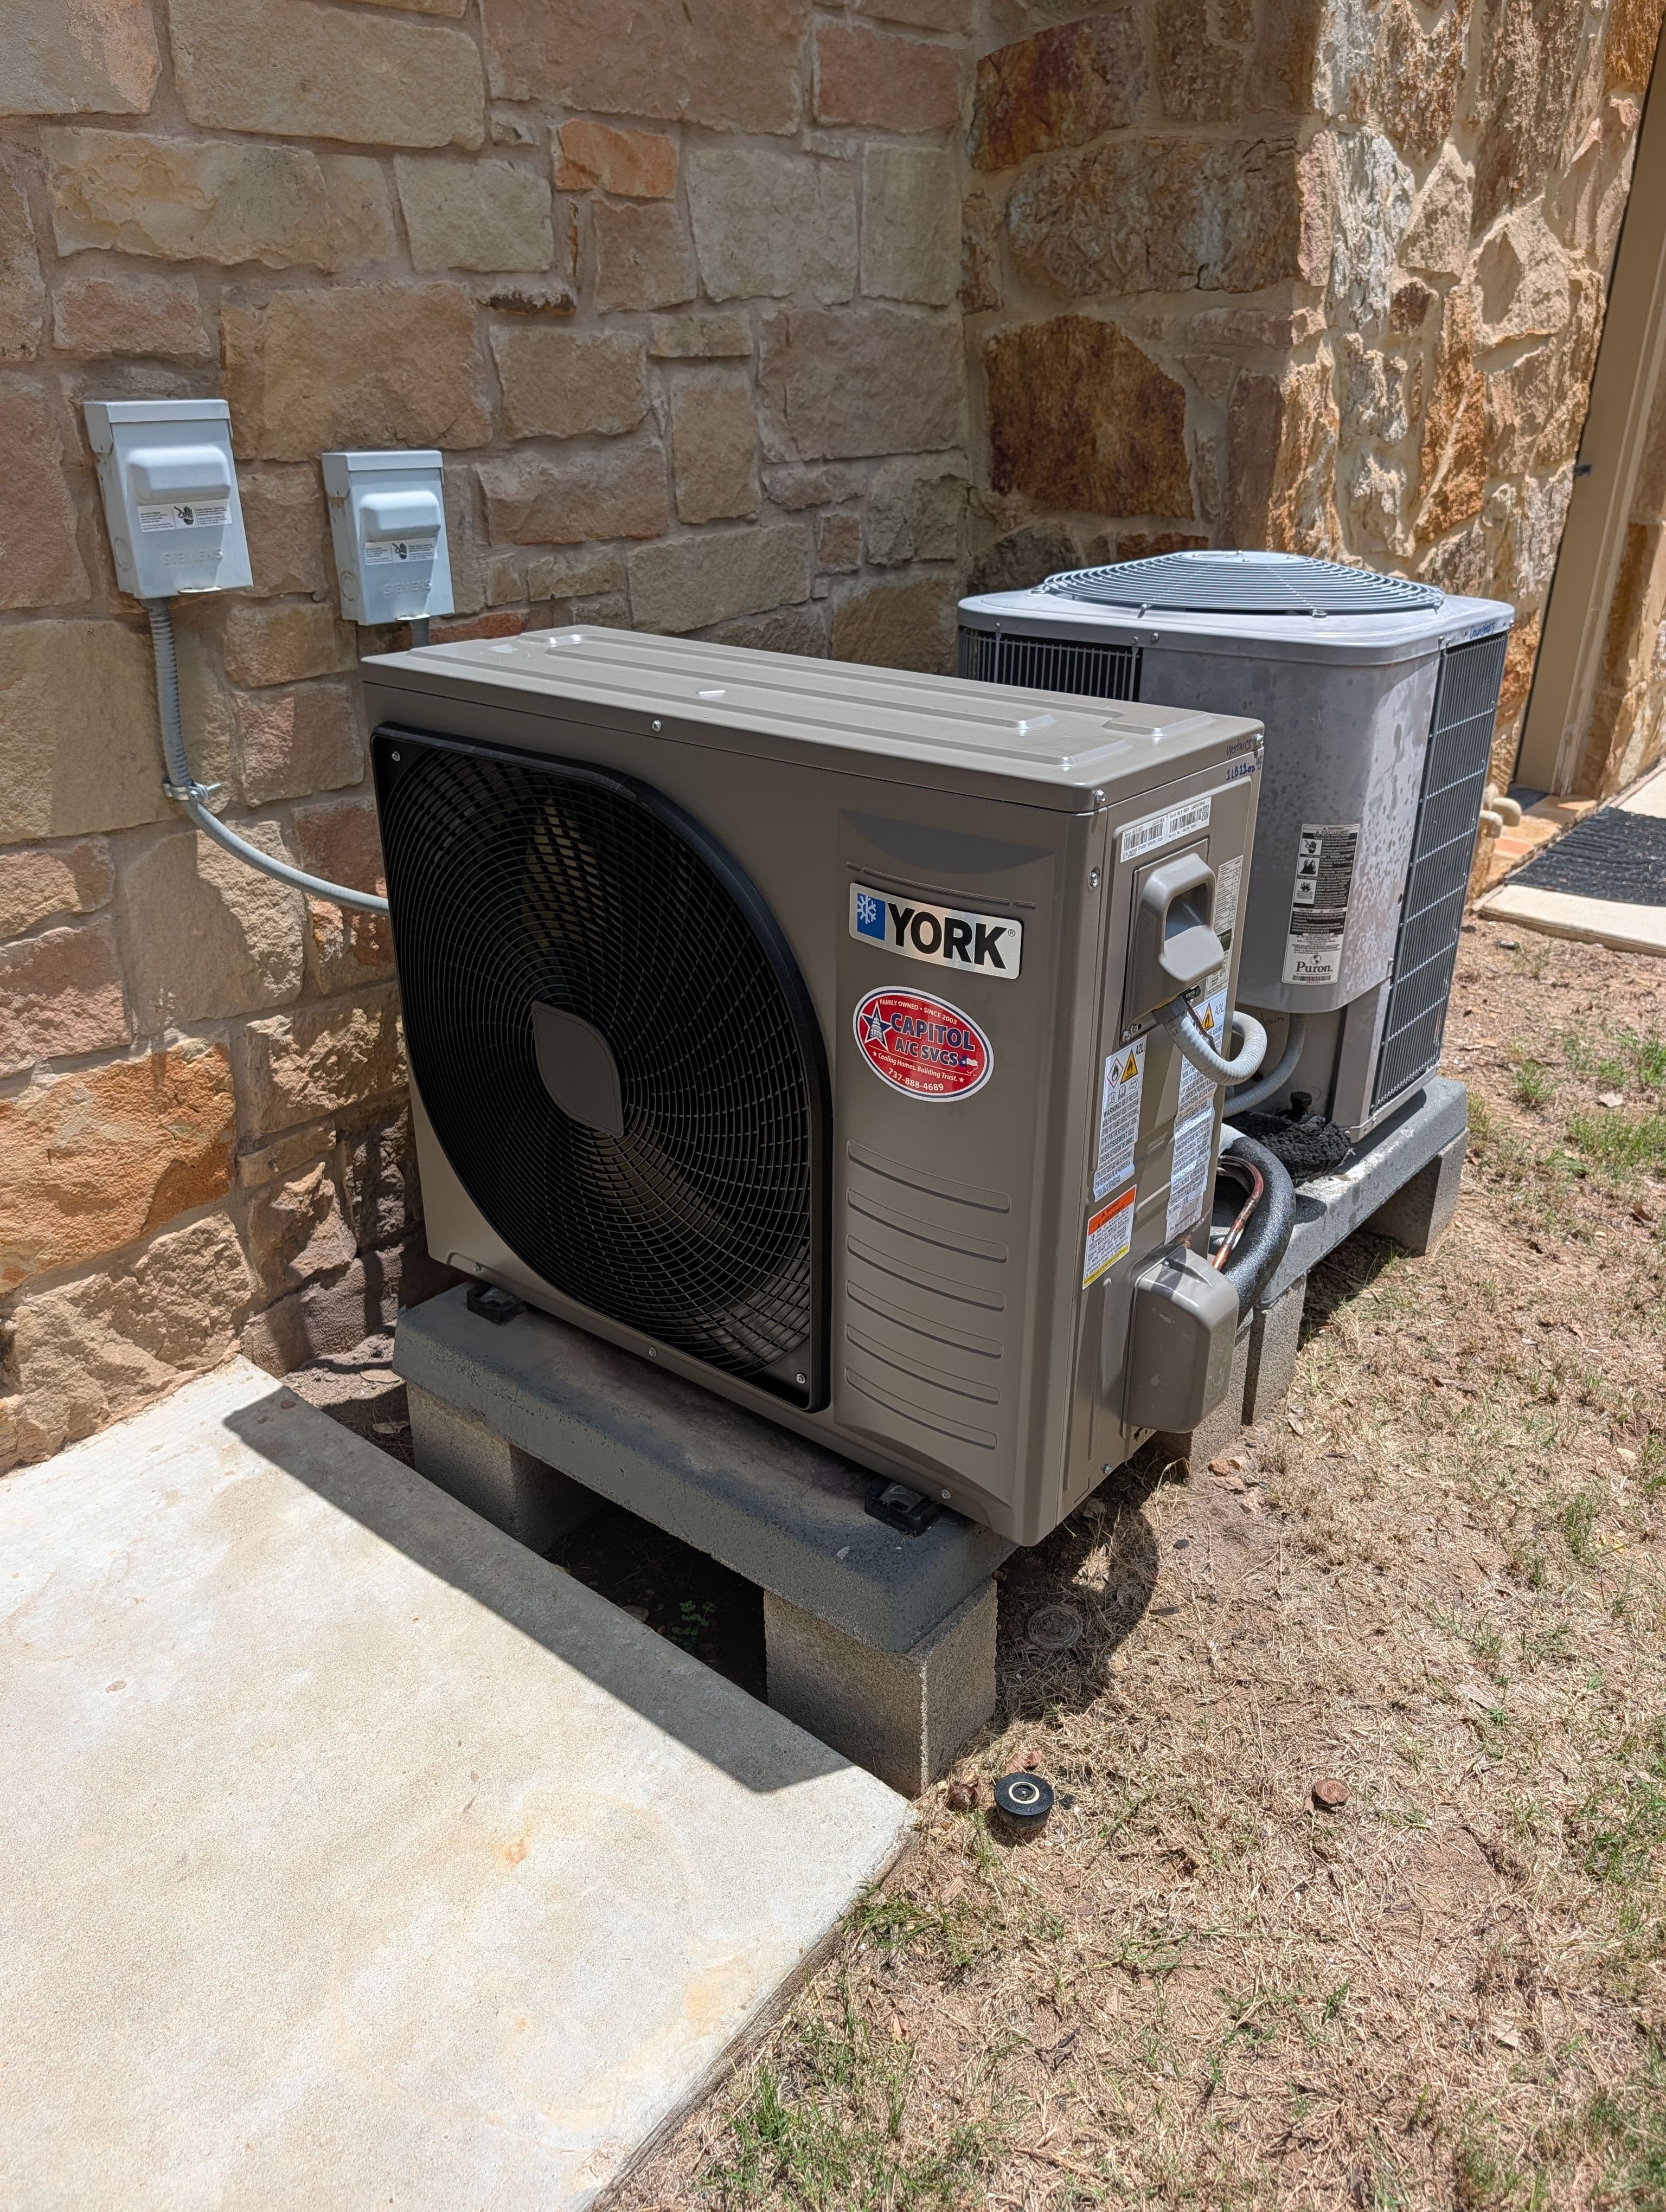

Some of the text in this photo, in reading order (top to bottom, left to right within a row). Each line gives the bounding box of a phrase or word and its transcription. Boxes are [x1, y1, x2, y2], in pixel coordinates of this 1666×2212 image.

[164, 549, 223, 565] SIEMENS
[385, 580, 432, 596] SIEMENS
[887, 902, 1008, 969] YORK
[1295, 961, 1331, 973] Puron
[898, 1001, 919, 1011] OWNED
[924, 1007, 941, 1018] SINCE
[942, 1014, 957, 1025] 2003
[1214, 1002, 1224, 1017] A2L
[891, 1013, 975, 1051] CAPITOL
[895, 1037, 958, 1067] A/C SVCS
[1135, 1041, 1144, 1057] A2L
[878, 1053, 958, 1082] Cooling Homes. Building Trust.
[888, 1068, 944, 1091] 737-888-4689
